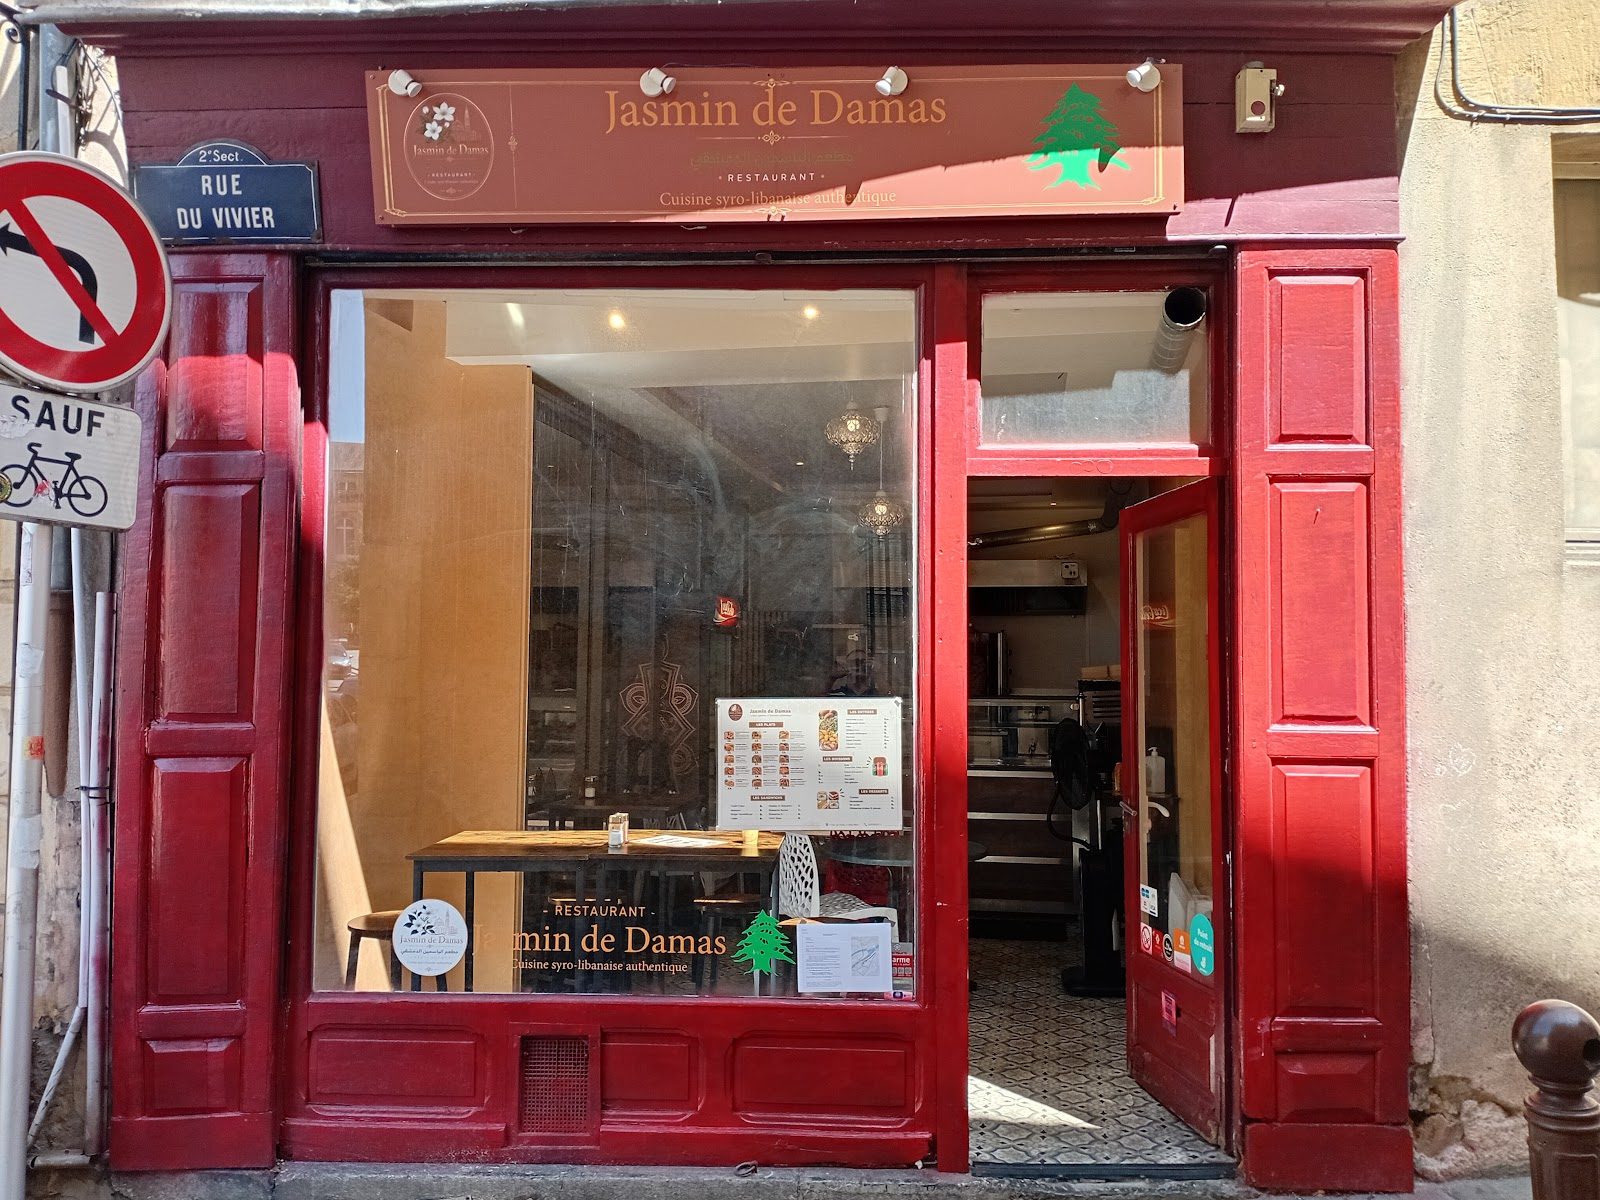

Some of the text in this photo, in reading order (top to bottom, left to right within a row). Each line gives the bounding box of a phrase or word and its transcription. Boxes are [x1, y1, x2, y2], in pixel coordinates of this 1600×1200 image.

[604, 86, 948, 134] Jasmin de Damas
[413, 143, 489, 157] Jasmin de Damas
[201, 174, 242, 195] RUE
[727, 172, 816, 183] RESTAURANT
[659, 188, 897, 210] Cuisine syro-libanaise authentique
[176, 206, 275, 229] DU VIVIER
[11, 394, 105, 437] SAUF
[555, 905, 646, 917] RESTAURANT
[400, 935, 464, 944] Jasmin de Damas
[581, 924, 615, 953] de
[624, 926, 727, 955] Damas
[512, 958, 688, 973] Cuisine syro-libanaise authentique
